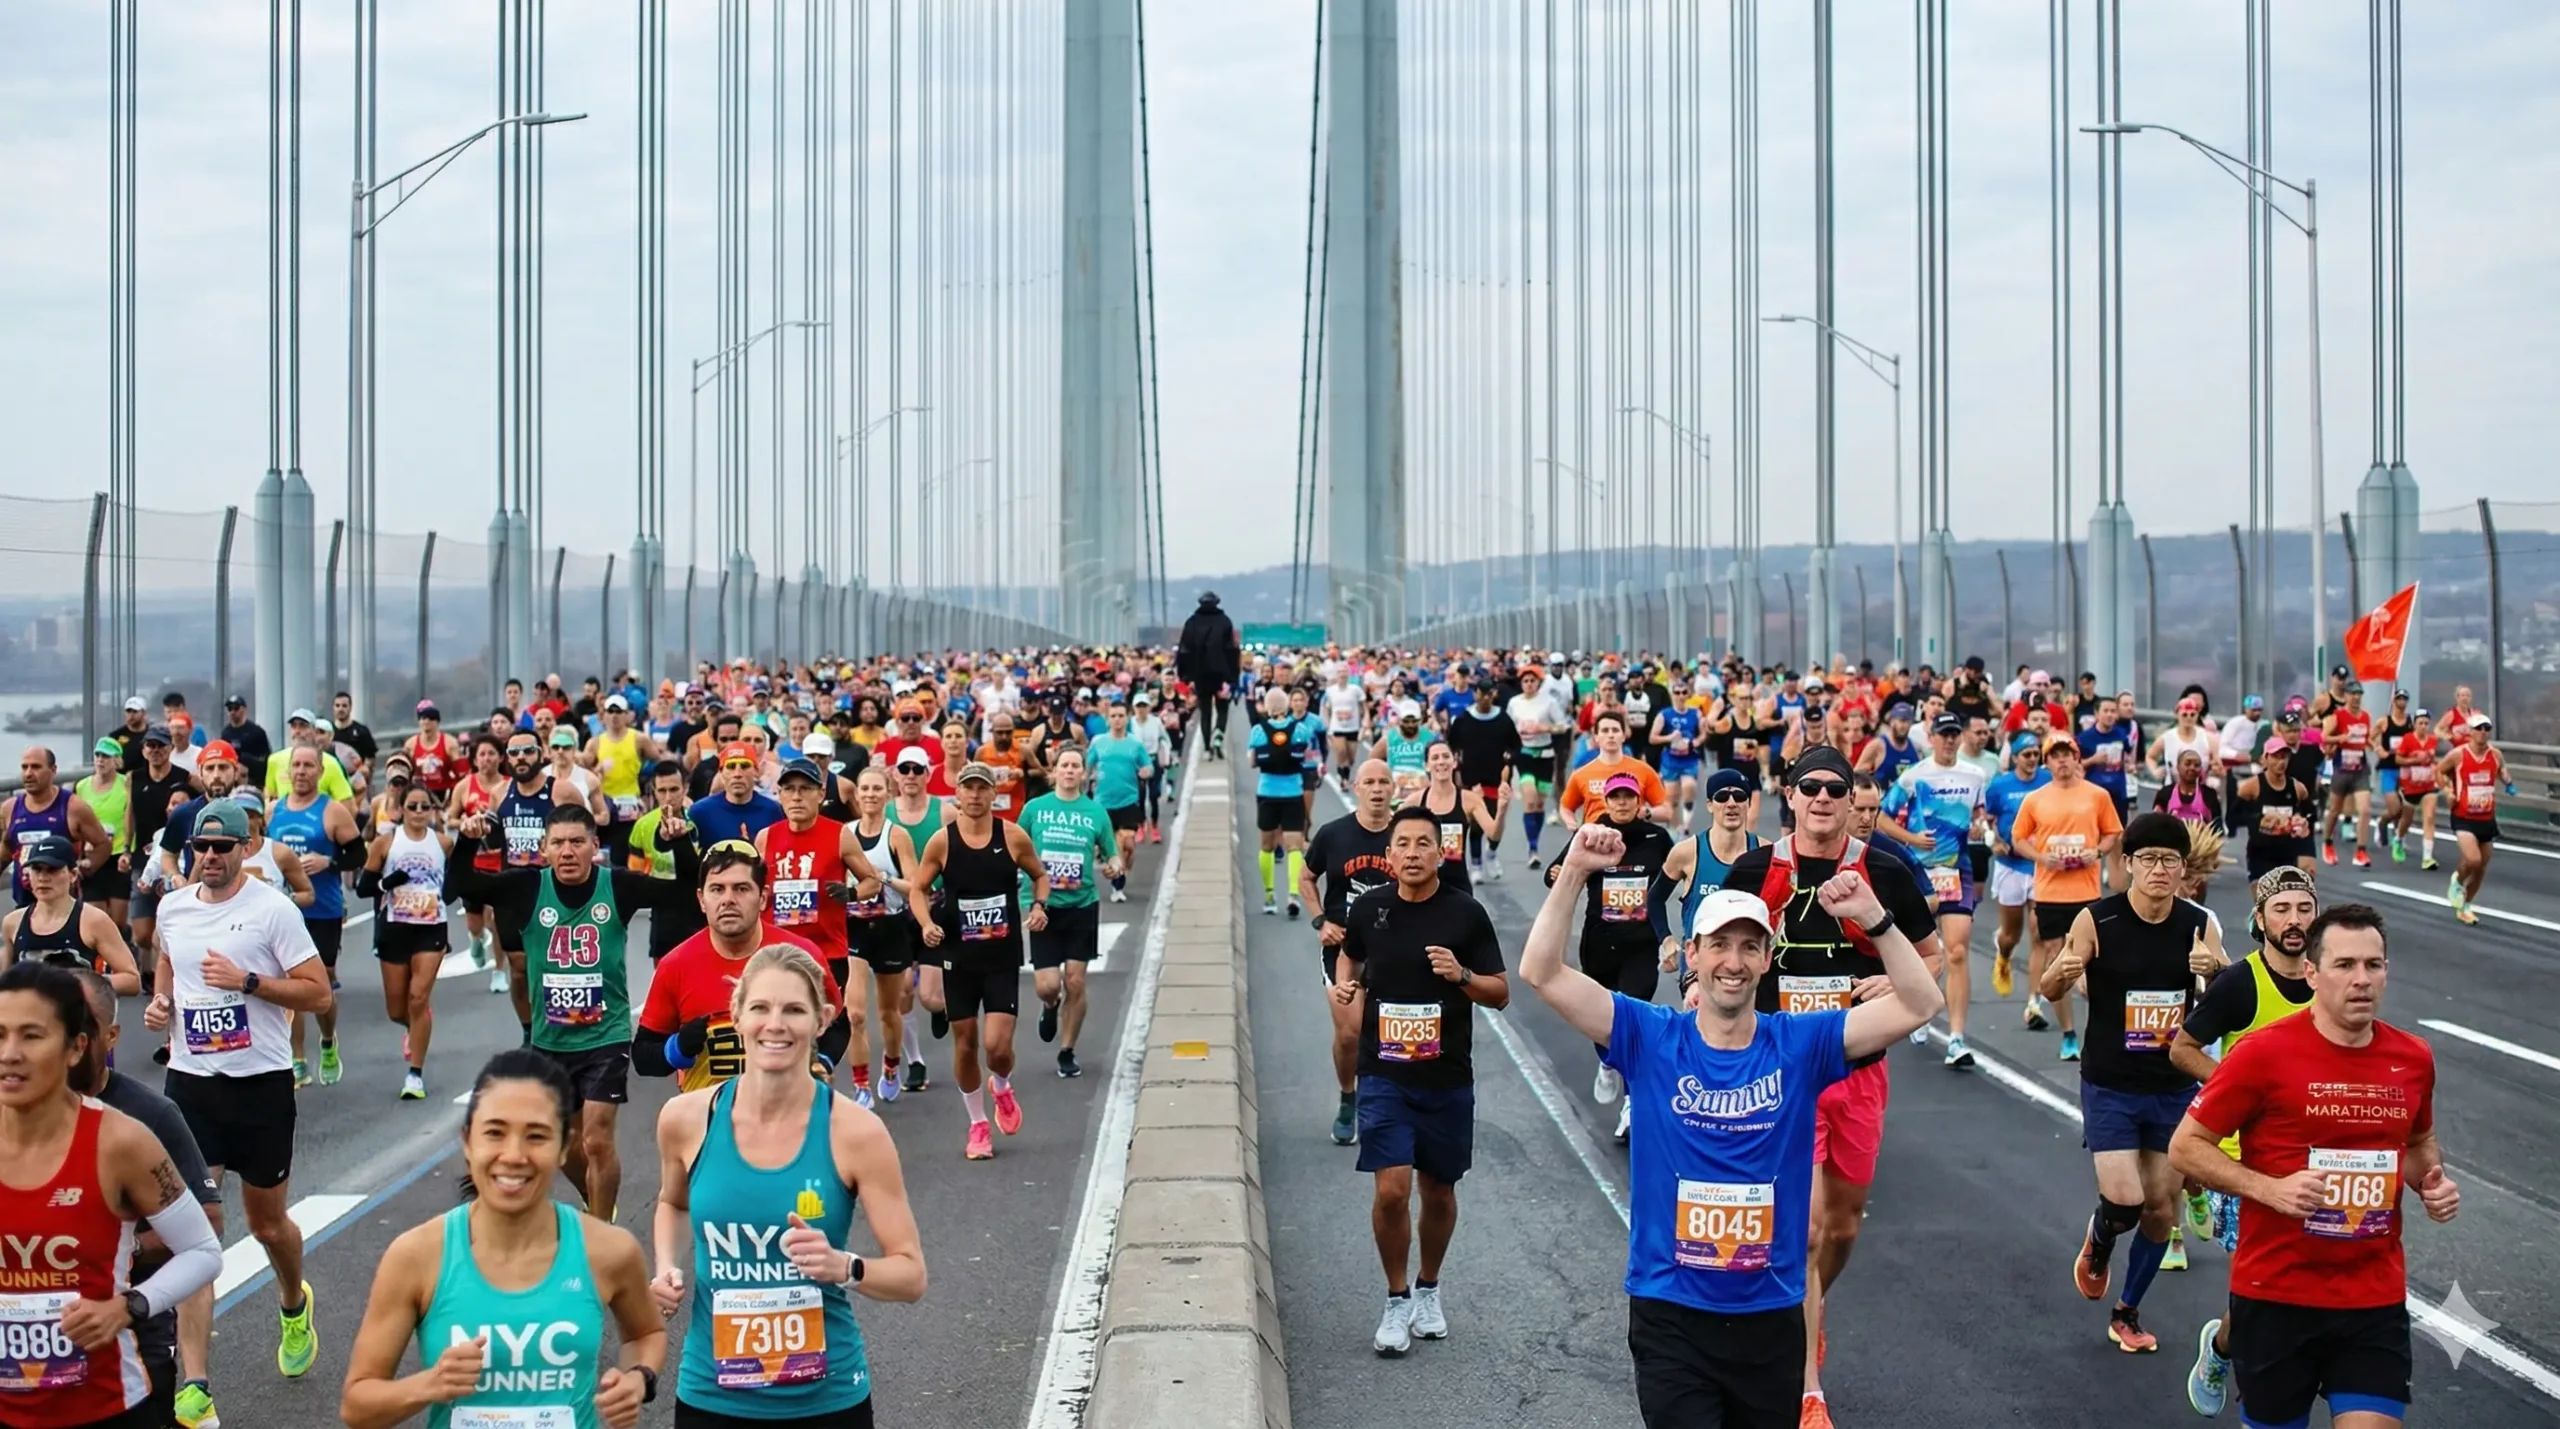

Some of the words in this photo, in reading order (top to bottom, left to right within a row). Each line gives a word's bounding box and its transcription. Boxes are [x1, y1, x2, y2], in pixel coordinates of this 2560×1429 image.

[965, 908, 1003, 926] 11472
[547, 924, 600, 968] 43
[1789, 993, 1841, 1013] 6255
[191, 1008, 237, 1034] 4153
[2134, 1006, 2182, 1029] 11472
[1385, 1020, 1436, 1041] 10235
[2305, 1104, 2408, 1120] MARATHONER
[2323, 1174, 2386, 1208] 5168
[1688, 1206, 1762, 1241] 8045
[0, 1272, 80, 1288] UNNER
[711, 1261, 815, 1282] RUNNE
[731, 1313, 806, 1356] 7319
[474, 1368, 576, 1392] UNNER
